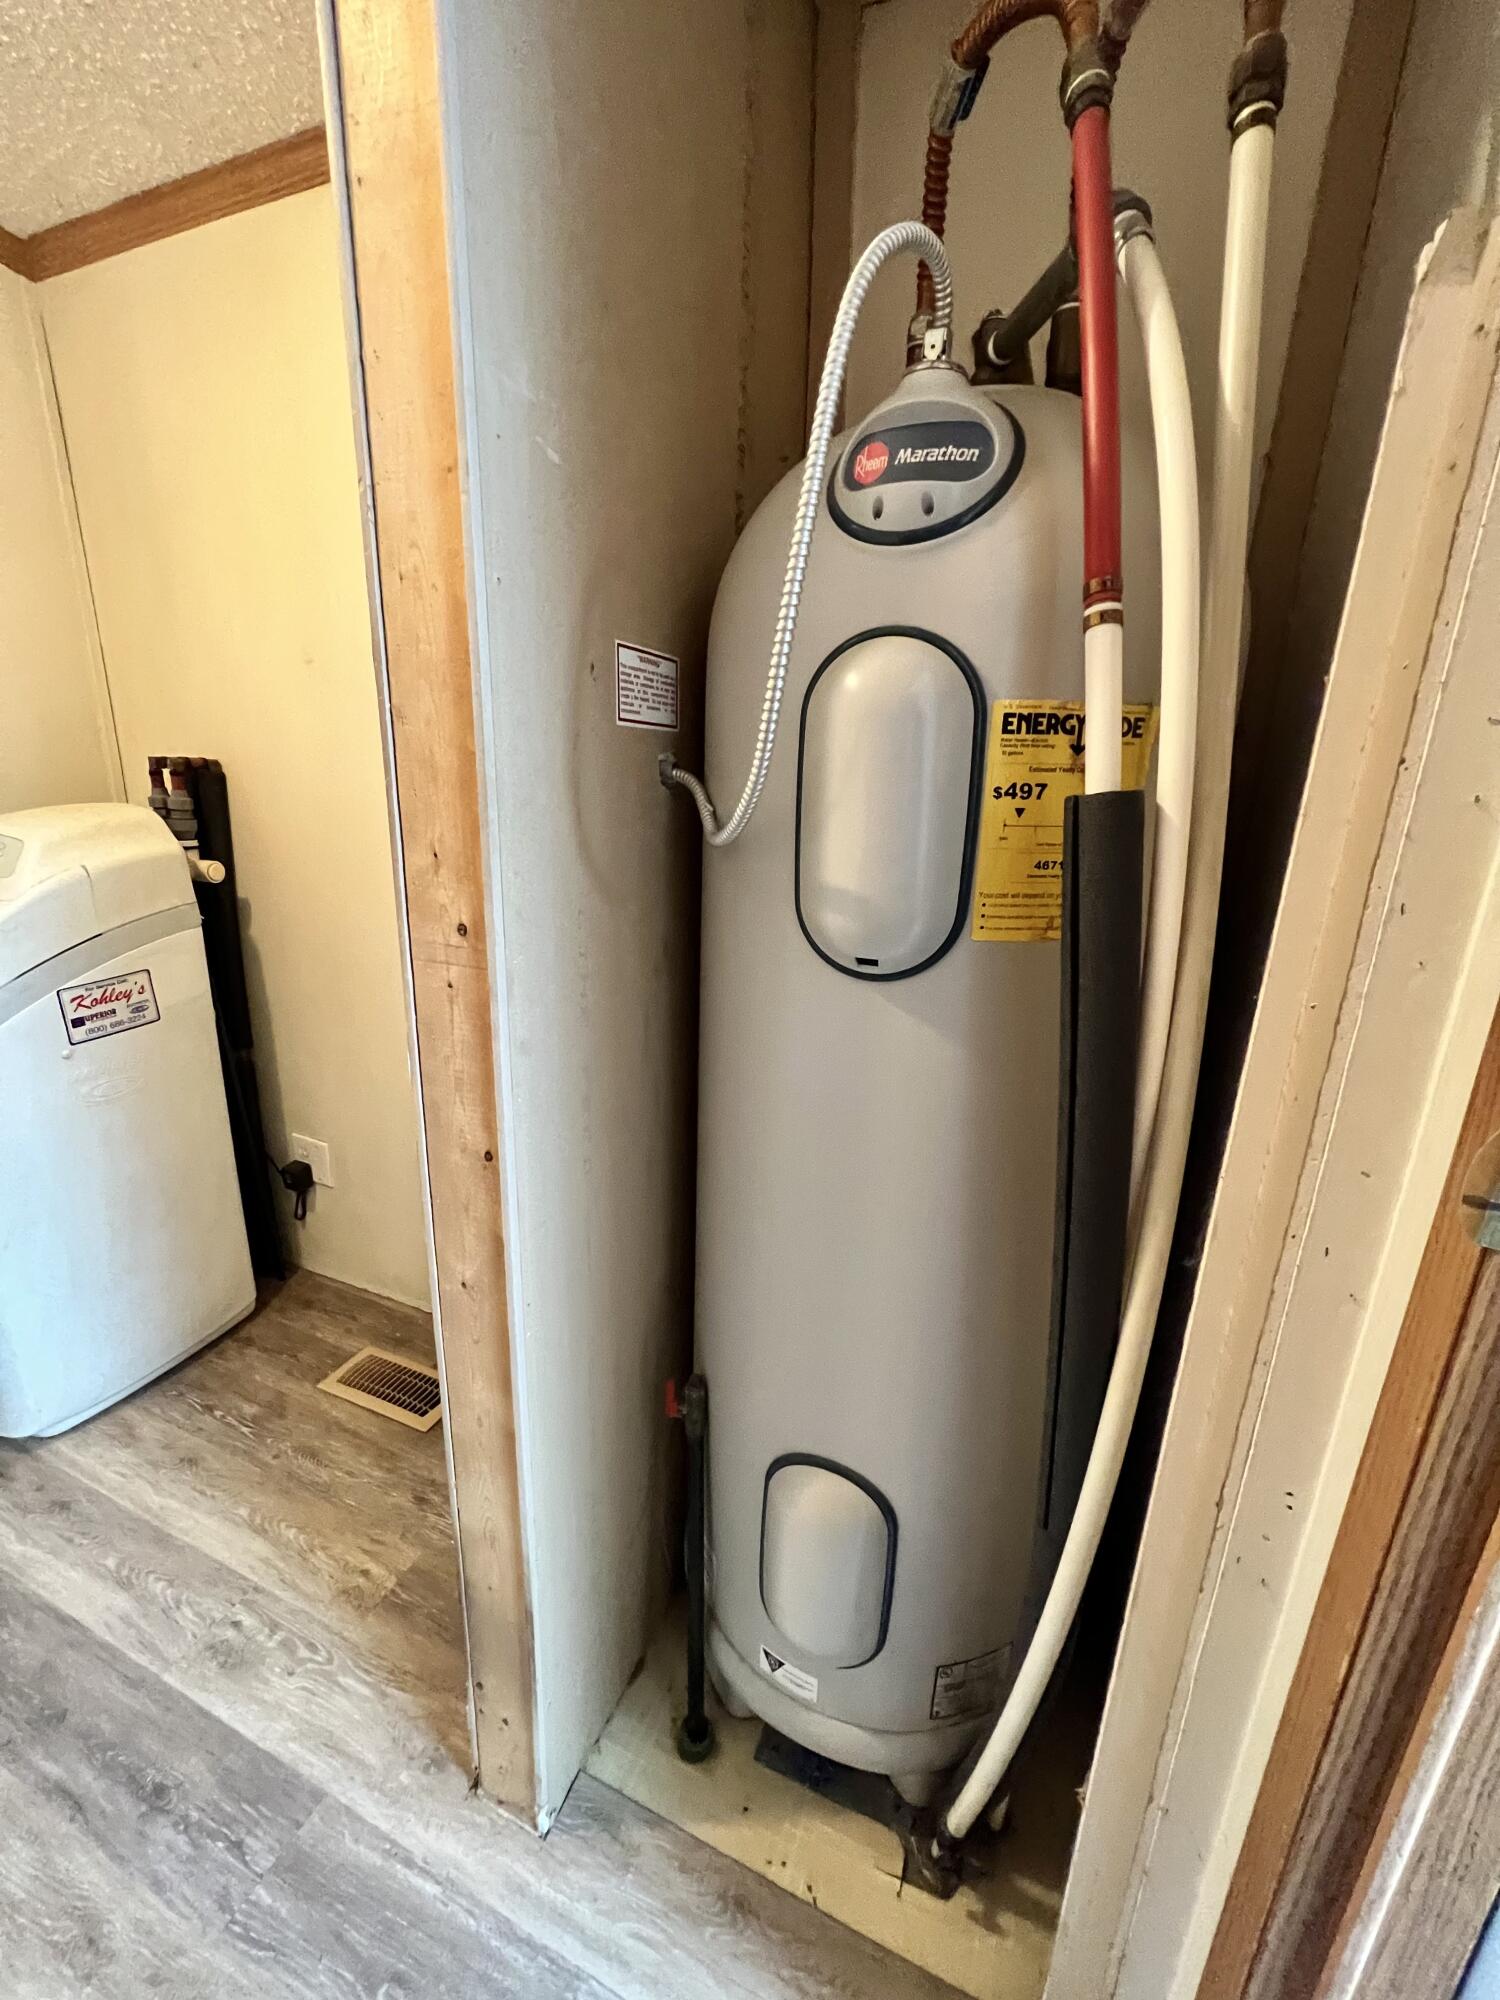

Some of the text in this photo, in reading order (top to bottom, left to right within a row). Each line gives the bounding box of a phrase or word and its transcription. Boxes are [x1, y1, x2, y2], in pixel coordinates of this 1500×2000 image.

[855, 446, 888, 478] Rheem
[895, 446, 979, 465] Marathon
[992, 782, 1048, 800] $497
[70, 982, 145, 1012] Kohley's
[85, 1025, 108, 1036] (800)
